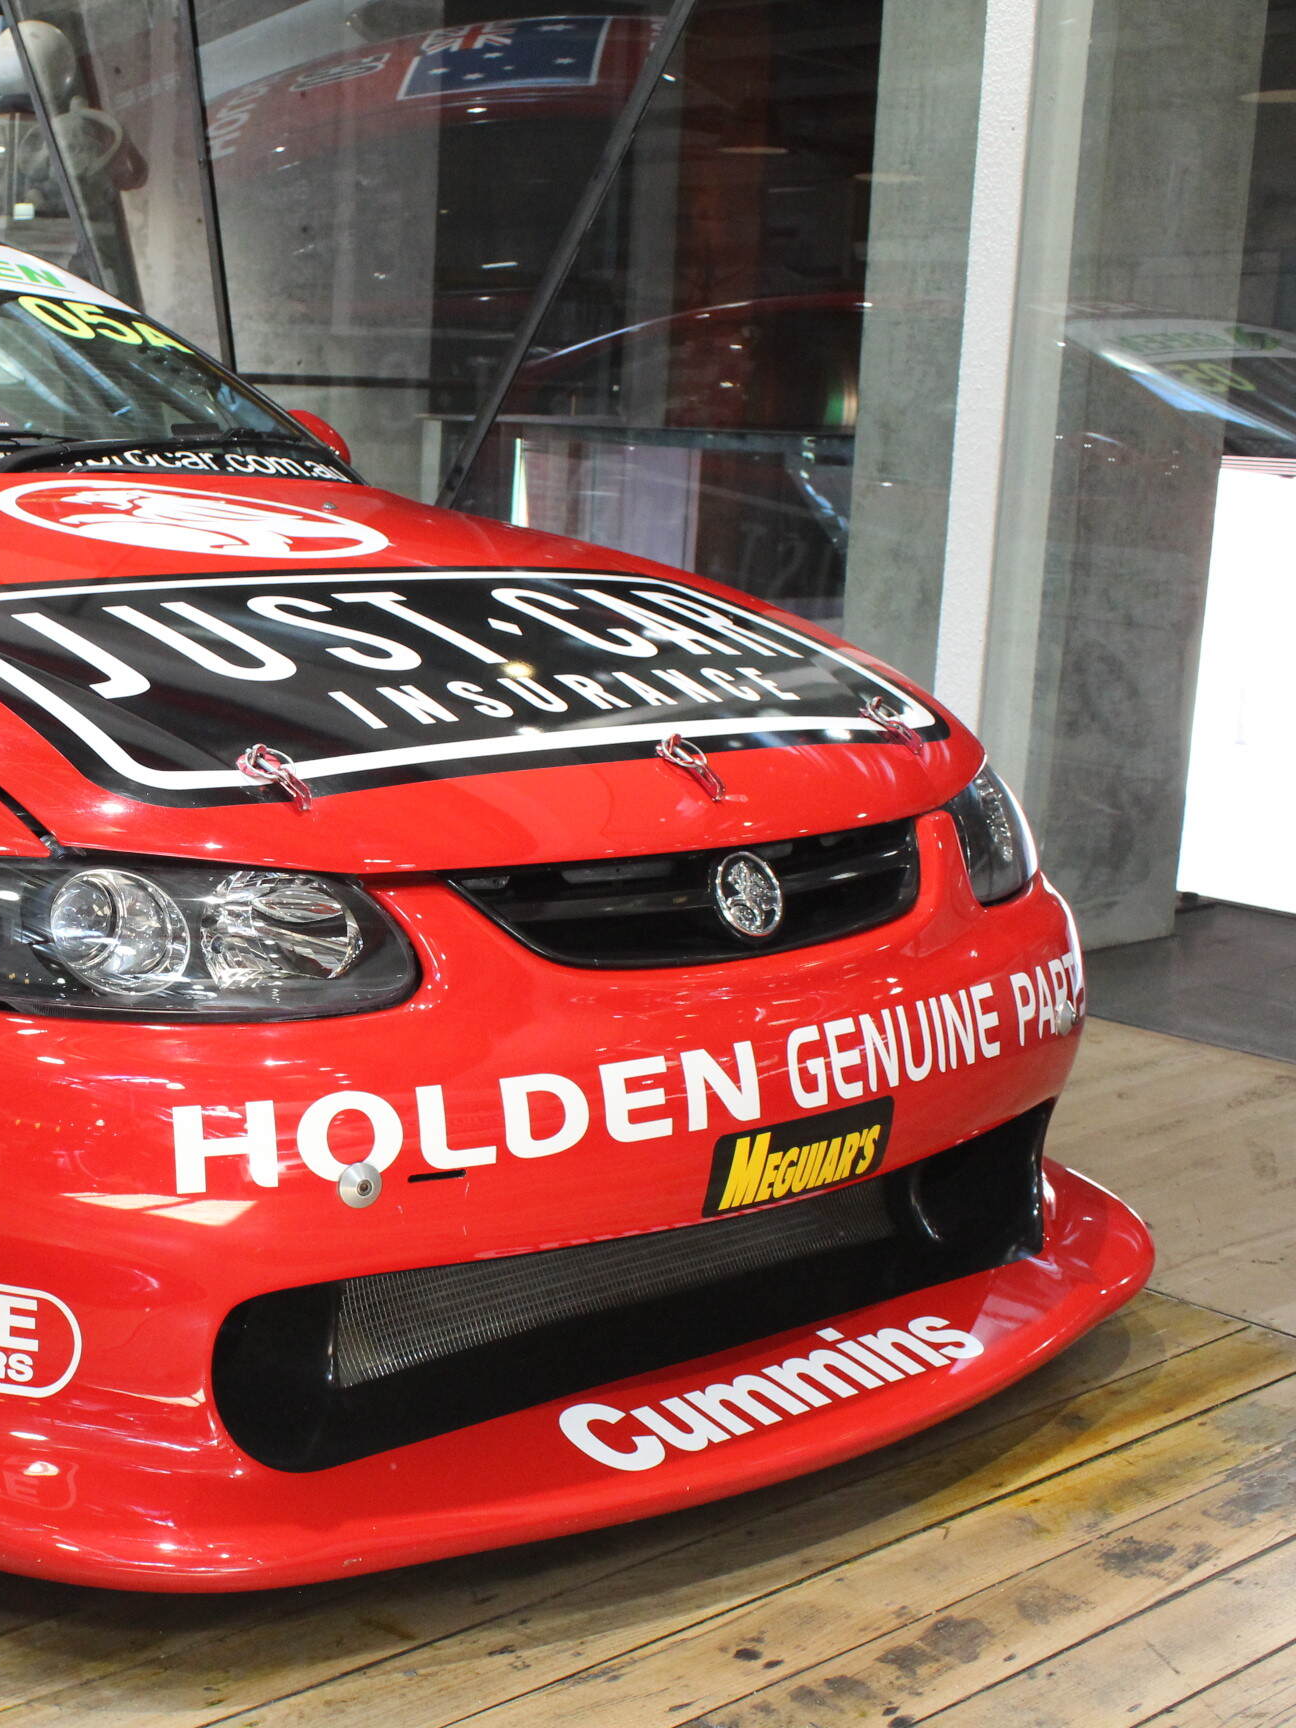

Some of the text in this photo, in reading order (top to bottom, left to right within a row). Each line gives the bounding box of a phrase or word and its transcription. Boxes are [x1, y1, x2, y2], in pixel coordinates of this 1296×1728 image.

[328, 666, 801, 730] INSURANCE
[172, 951, 1086, 1195] HOLDEN GENUINE PART
[718, 1123, 880, 1211] MEGUIAR'S
[558, 1315, 985, 1472] Cummins
